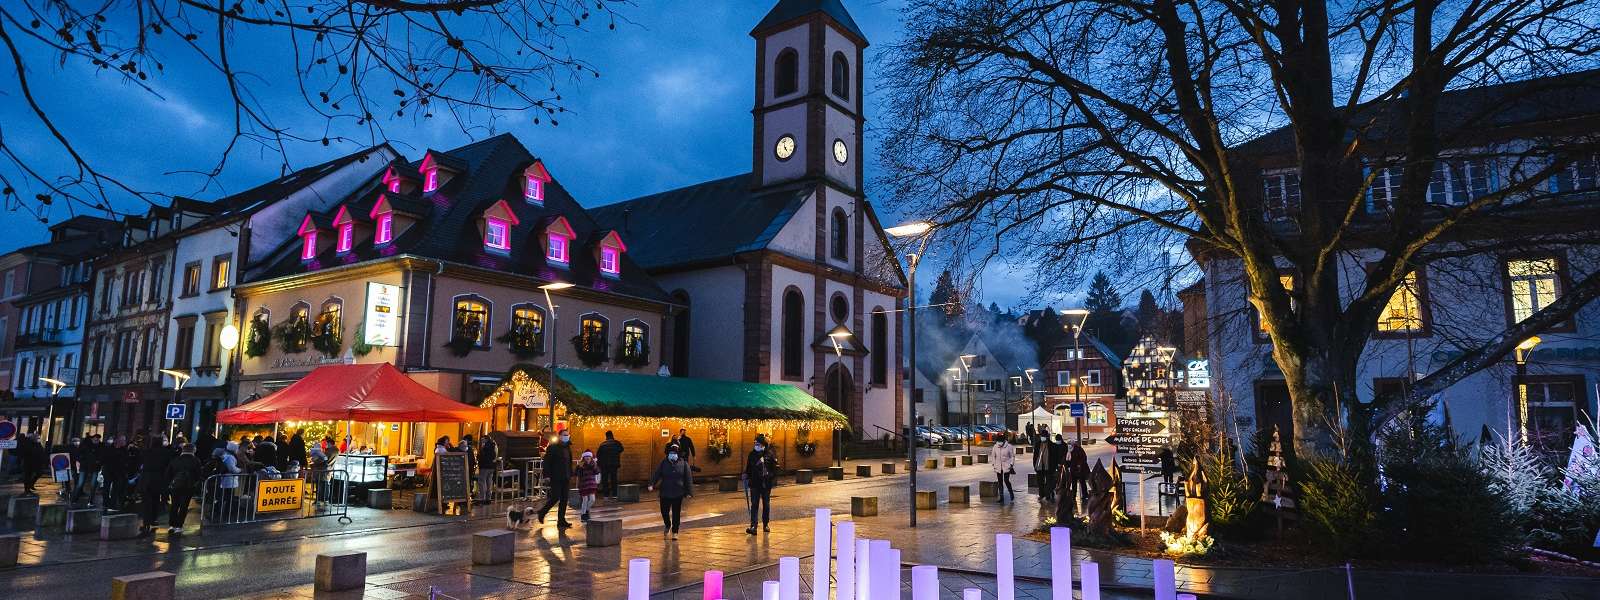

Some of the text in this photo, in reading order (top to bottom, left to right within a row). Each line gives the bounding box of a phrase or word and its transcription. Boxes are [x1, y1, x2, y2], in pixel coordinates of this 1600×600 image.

[172, 407, 180, 416] P
[265, 485, 296, 495] ROUTE
[262, 496, 297, 506] BARRÉE
